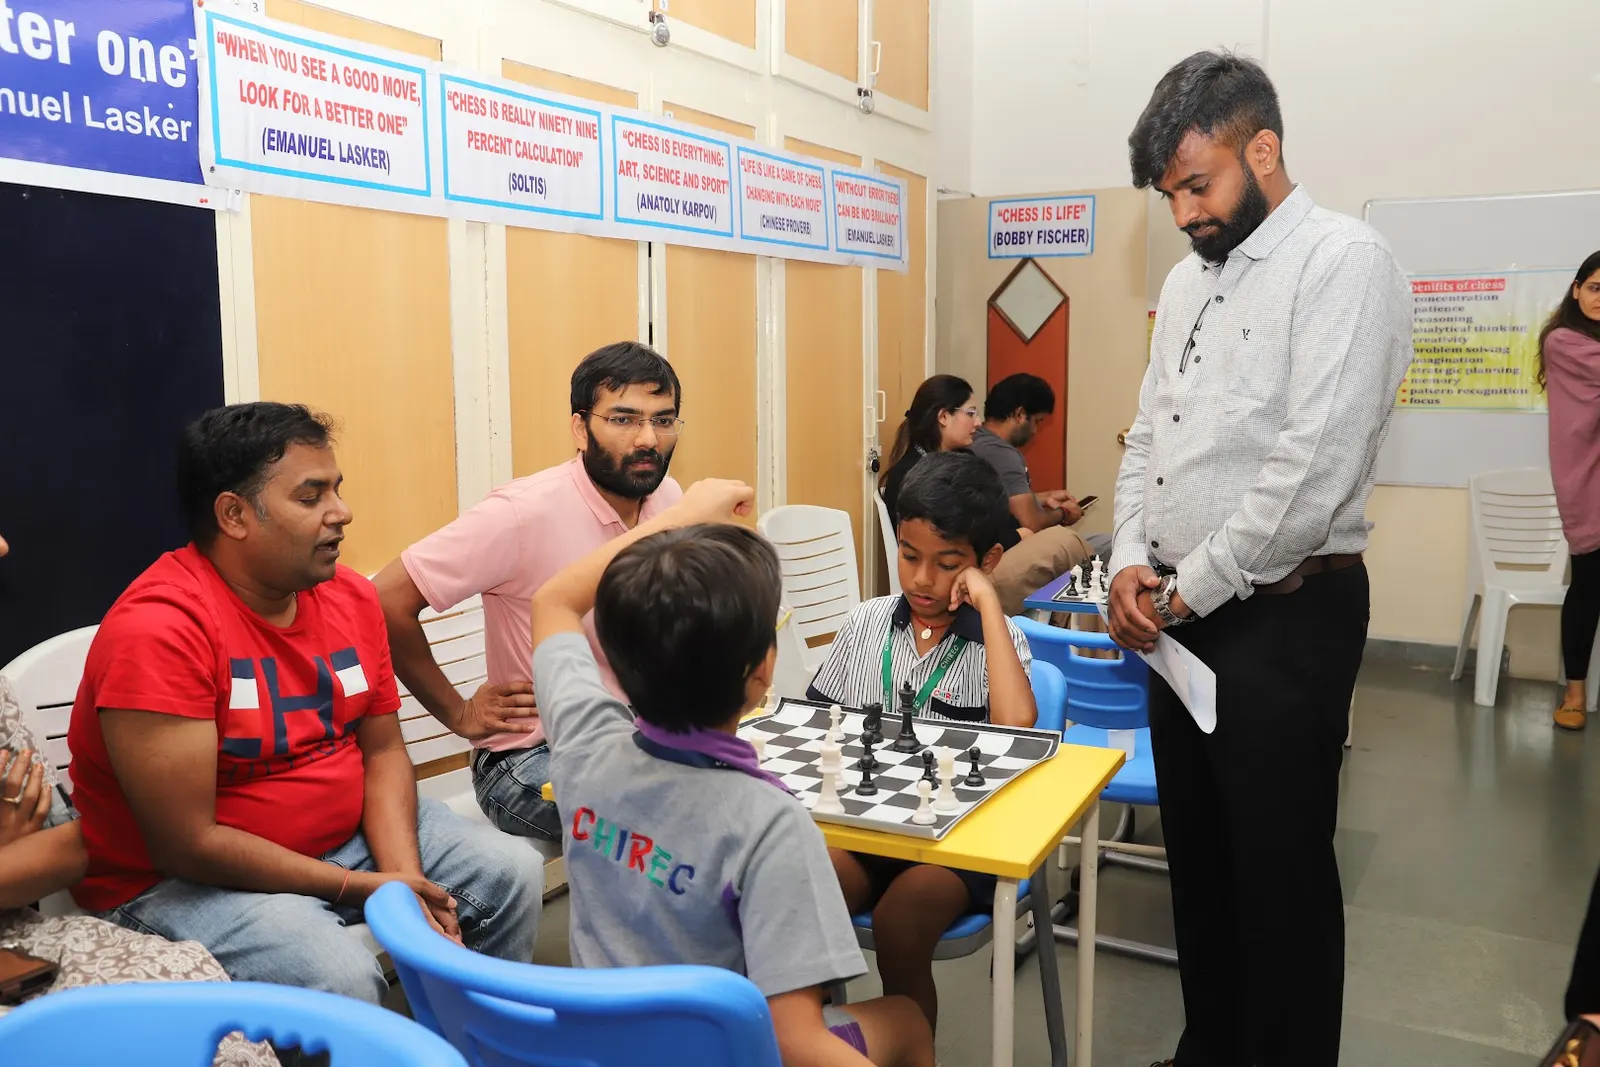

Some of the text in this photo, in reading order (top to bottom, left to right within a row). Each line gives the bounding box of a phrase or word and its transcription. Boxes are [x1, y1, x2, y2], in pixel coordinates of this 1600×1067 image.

[216, 31, 420, 108] “WHEN YOU SEE A GOOD MOVE,
[83, 95, 192, 142] Lasker
[239, 79, 408, 136] LOOK FOR A BETTER ONE”
[447, 90, 598, 140] “CHESS IS REALLY NINETY NINE
[262, 127, 390, 176] (EMANUEL LASKER)
[468, 130, 584, 168] PERCENT CALCULATION”
[622, 130, 724, 168] “CHESS IS EVERYTHING:
[508, 172, 546, 200] (SOLTIS)
[618, 160, 640, 182] ART,
[642, 164, 680, 186] SCIENCE
[682, 172, 700, 190] AND
[757, 162, 762, 176] IS
[764, 164, 776, 180] LIKE
[782, 168, 796, 184] GAME
[805, 174, 822, 190] CHESS
[636, 192, 717, 224] (ANATOLY KARPOV)
[746, 185, 775, 204] CHANGING
[776, 192, 790, 206] WITH
[790, 194, 805, 209] EACH
[837, 204, 850, 217] CAN
[852, 206, 860, 219] BE
[861, 208, 870, 220] NO
[998, 204, 1086, 224] “CHESS IS LIFE”
[993, 228, 1090, 250] (BOBBY FISCHER)
[1456, 280, 1468, 290] of
[1471, 279, 1504, 290] chess
[1414, 294, 1499, 302] concentration
[1414, 305, 1465, 314] patience
[1413, 325, 1471, 335] analytical
[1414, 314, 1474, 324] reasoning
[1412, 335, 1468, 345] creativity
[1465, 346, 1510, 355] solving
[1411, 367, 1520, 376] strategic planning
[1411, 378, 1461, 386] memory
[1410, 387, 1528, 396] pattern recognition
[940, 645, 959, 668] CHIREC
[572, 807, 695, 895] CHIREC
